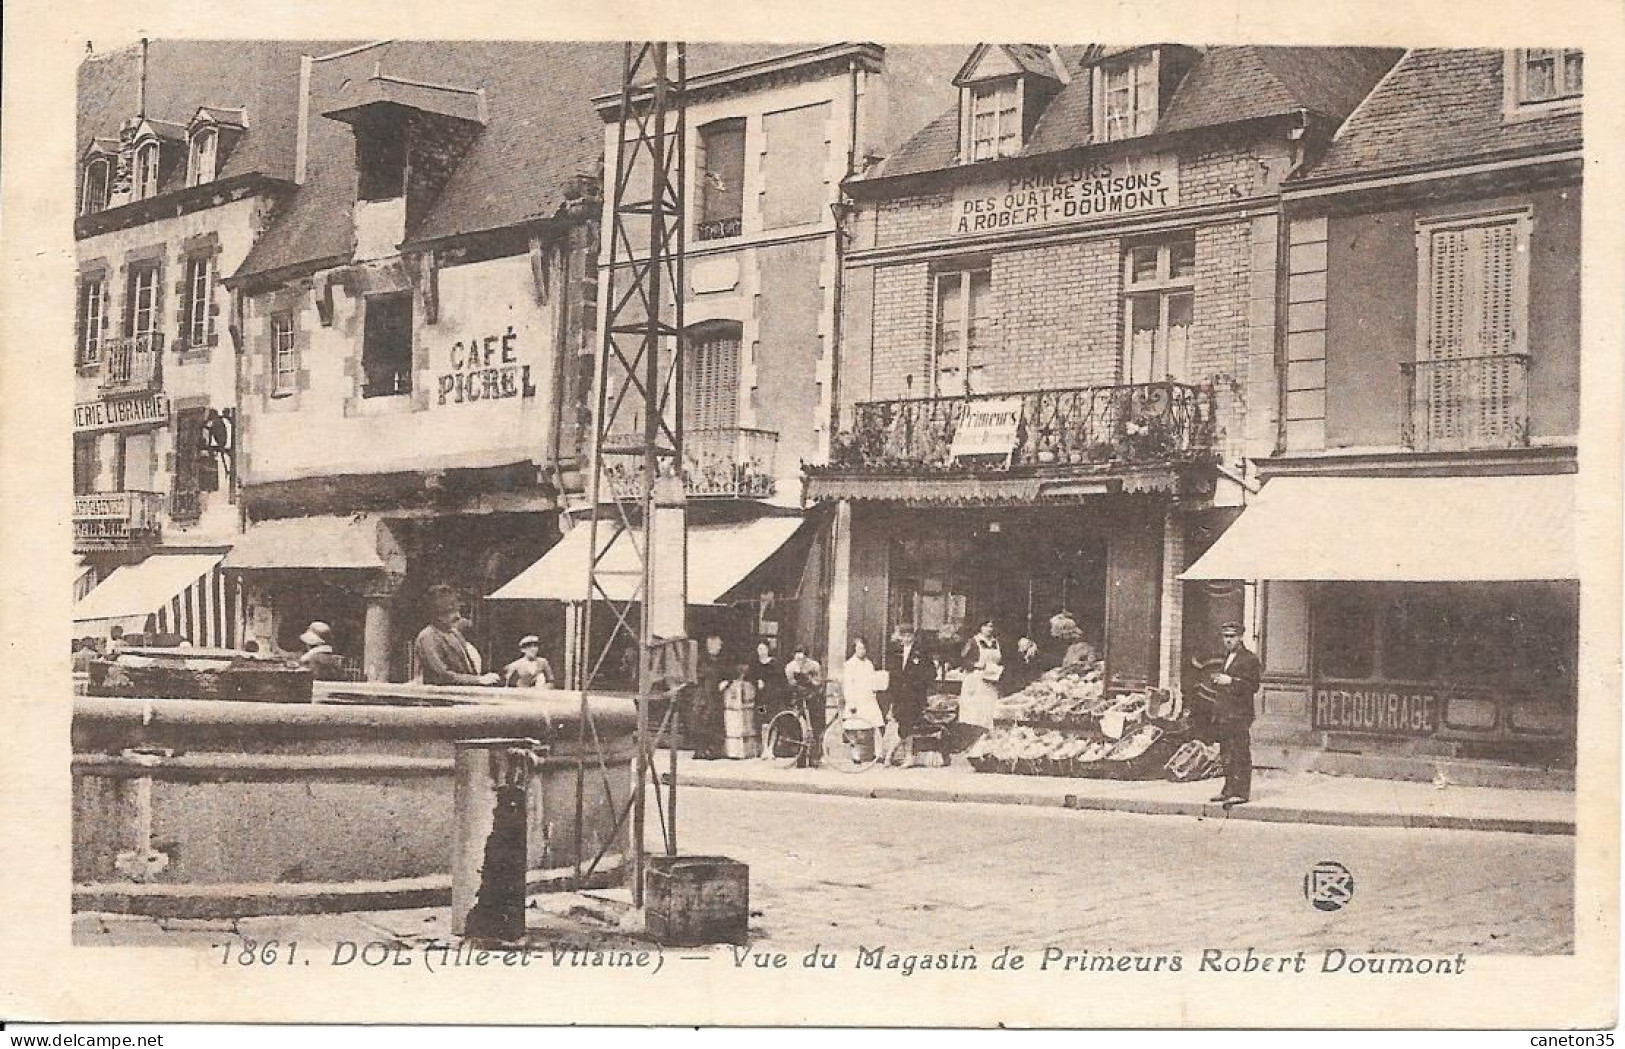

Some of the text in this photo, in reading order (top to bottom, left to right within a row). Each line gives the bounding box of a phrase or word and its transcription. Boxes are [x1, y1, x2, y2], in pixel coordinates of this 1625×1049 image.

[963, 170, 1161, 214] DES QUATRE SAISONS
[1007, 164, 1112, 192] PRIMEURS
[451, 326, 517, 370] CAFÉ
[106, 395, 165, 423] LIBRAIRIE
[1316, 689, 1434, 730] RECOUVRAGE
